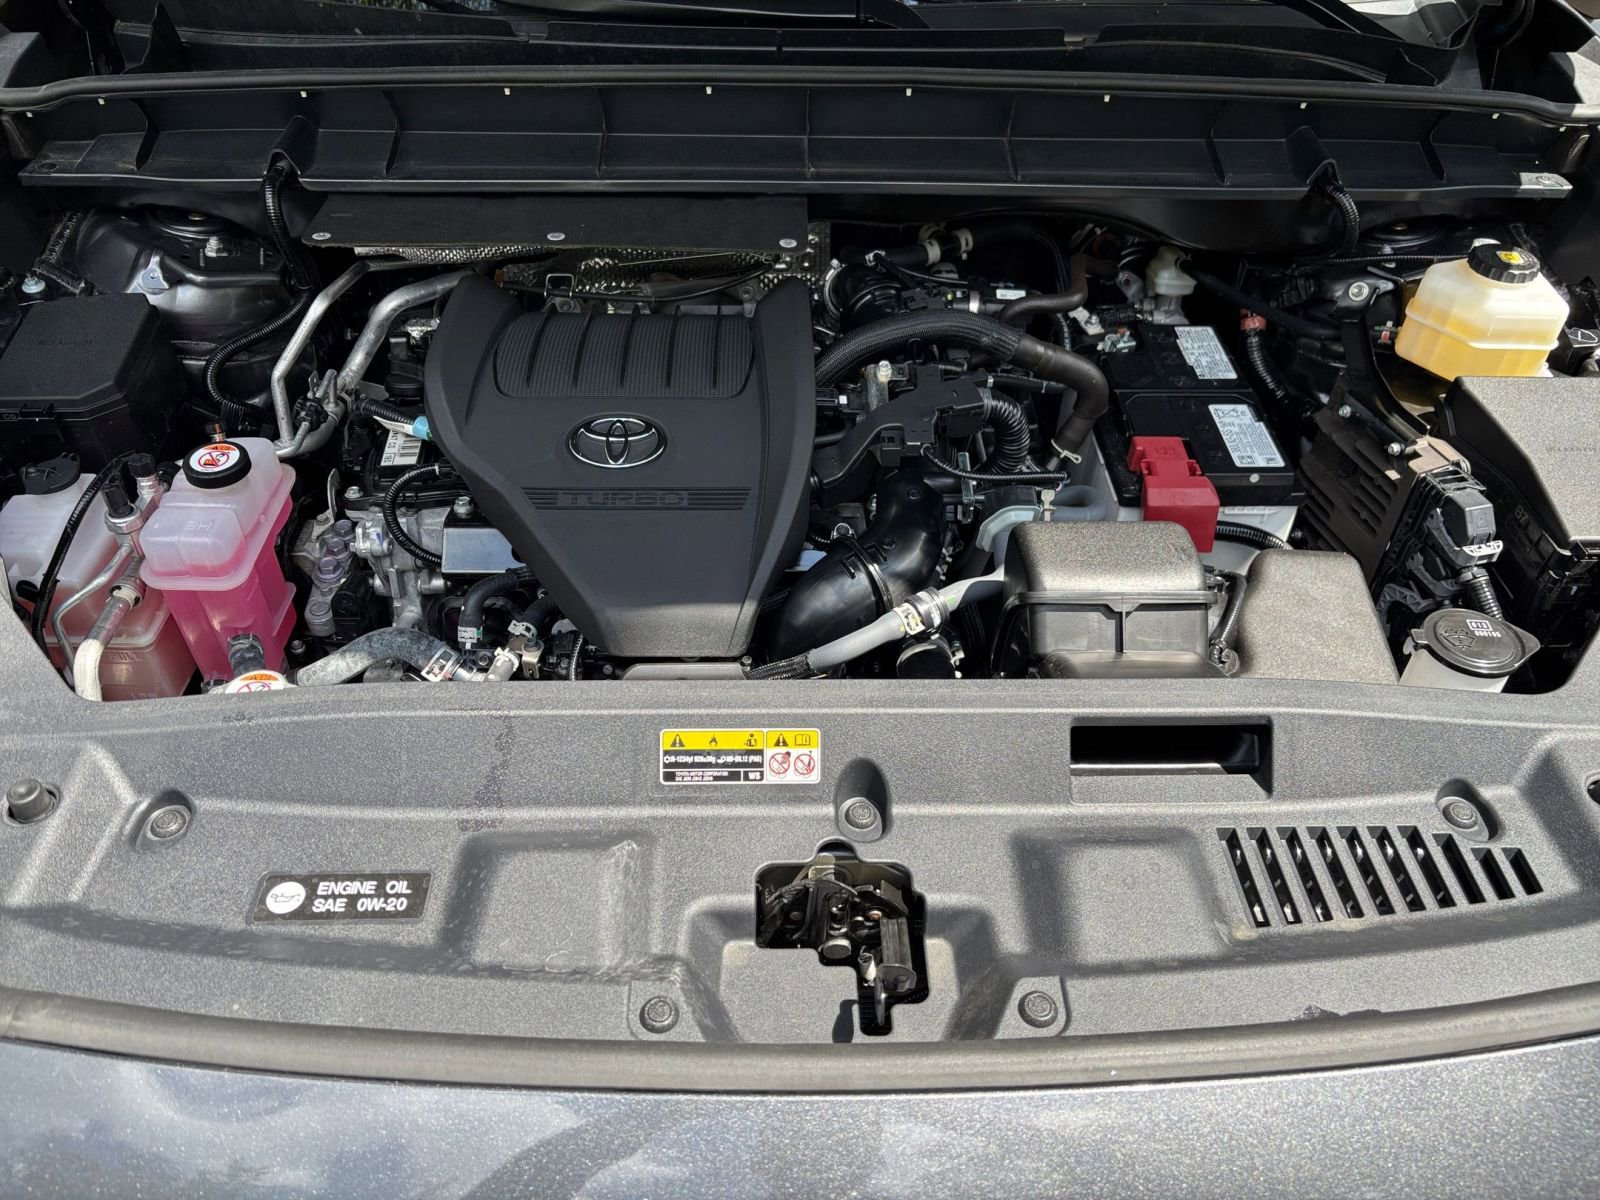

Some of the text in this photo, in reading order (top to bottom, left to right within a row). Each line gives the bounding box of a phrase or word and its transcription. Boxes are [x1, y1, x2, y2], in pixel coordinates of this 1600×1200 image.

[559, 491, 686, 506] TURBO
[317, 881, 412, 895] ENGINE OIL
[312, 898, 408, 912] SAE 0W-20
